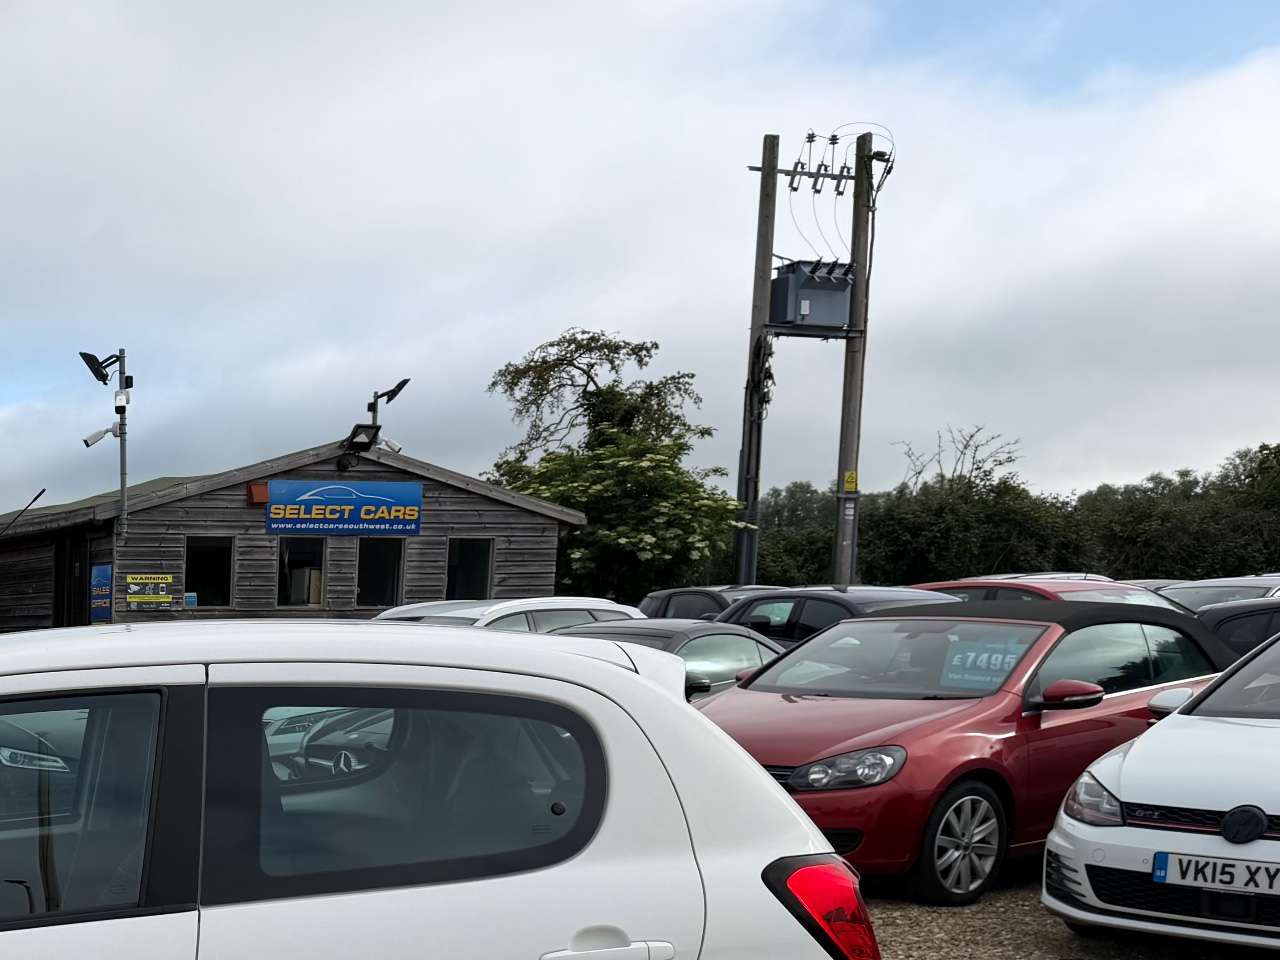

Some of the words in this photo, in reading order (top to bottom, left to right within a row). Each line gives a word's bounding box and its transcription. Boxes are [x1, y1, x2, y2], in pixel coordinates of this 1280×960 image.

[270, 504, 355, 519] SELECT
[360, 505, 419, 520] CARS
[271, 522, 417, 530] www.selectcarssouthwest.co.uk
[1135, 808, 1161, 819] GTI
[1178, 858, 1237, 886] VK15
